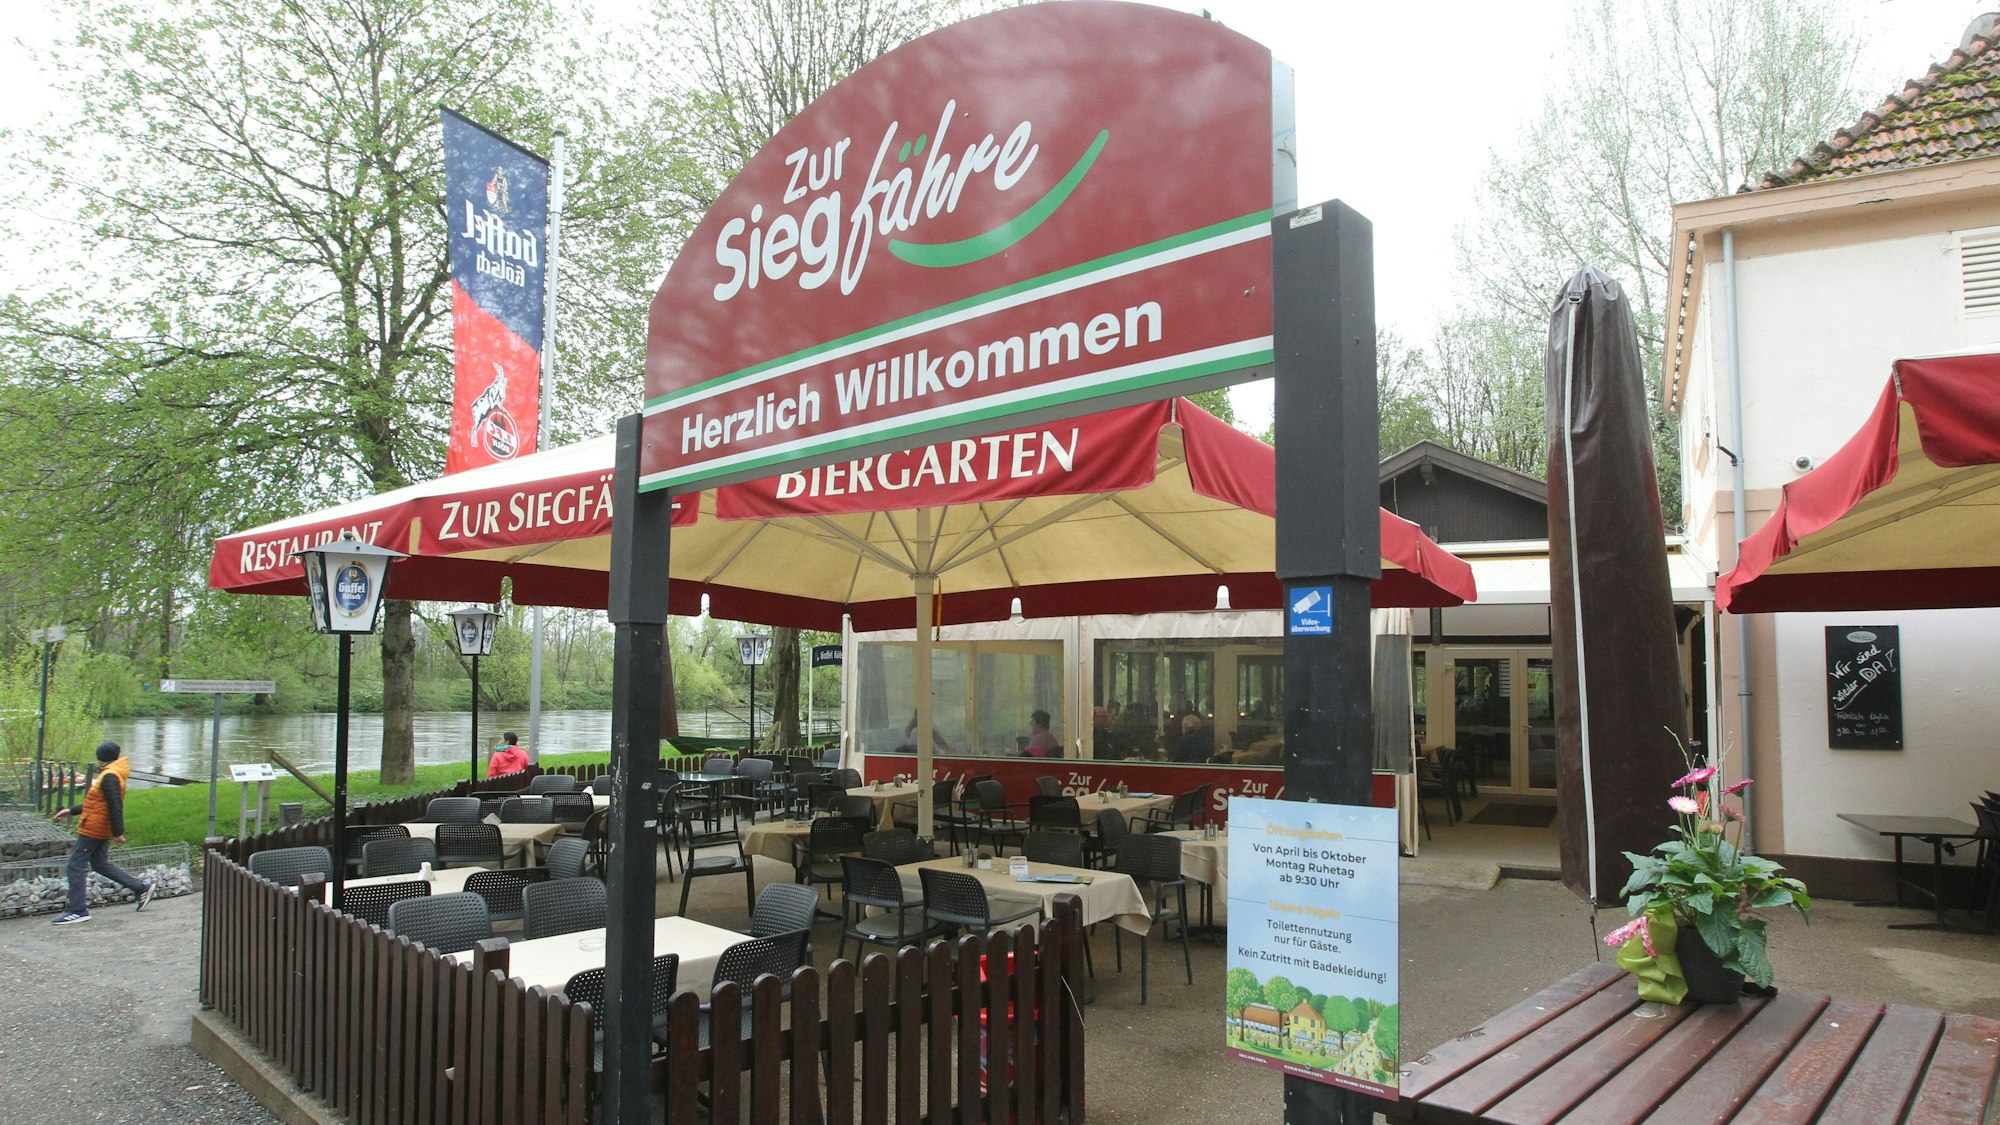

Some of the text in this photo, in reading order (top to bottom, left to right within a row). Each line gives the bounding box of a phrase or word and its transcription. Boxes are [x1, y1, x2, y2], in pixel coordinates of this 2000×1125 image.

[783, 137, 851, 204] Zur
[681, 301, 1162, 455] Herzlich Willkommen
[775, 427, 1079, 499] BIERGARTEN
[438, 501, 501, 541] ZUR
[338, 582, 366, 593] Gaffel
[1829, 644, 1881, 679] Wir sind
[1832, 680, 1858, 702] wieder
[1069, 772, 1092, 785] Zur
[1242, 779, 1268, 793] Zur
[1253, 843, 1367, 864] Von April bis Oktober
[1266, 858, 1355, 878] Montag Ruhetag
[1280, 874, 1340, 889] ab 9:30 Uhr
[1267, 919, 1352, 943] Toilettennutzung
[1274, 935, 1341, 954] nur für Gäste.
[1238, 947, 1387, 984] Kein Zutritt mit Badekleidung!
